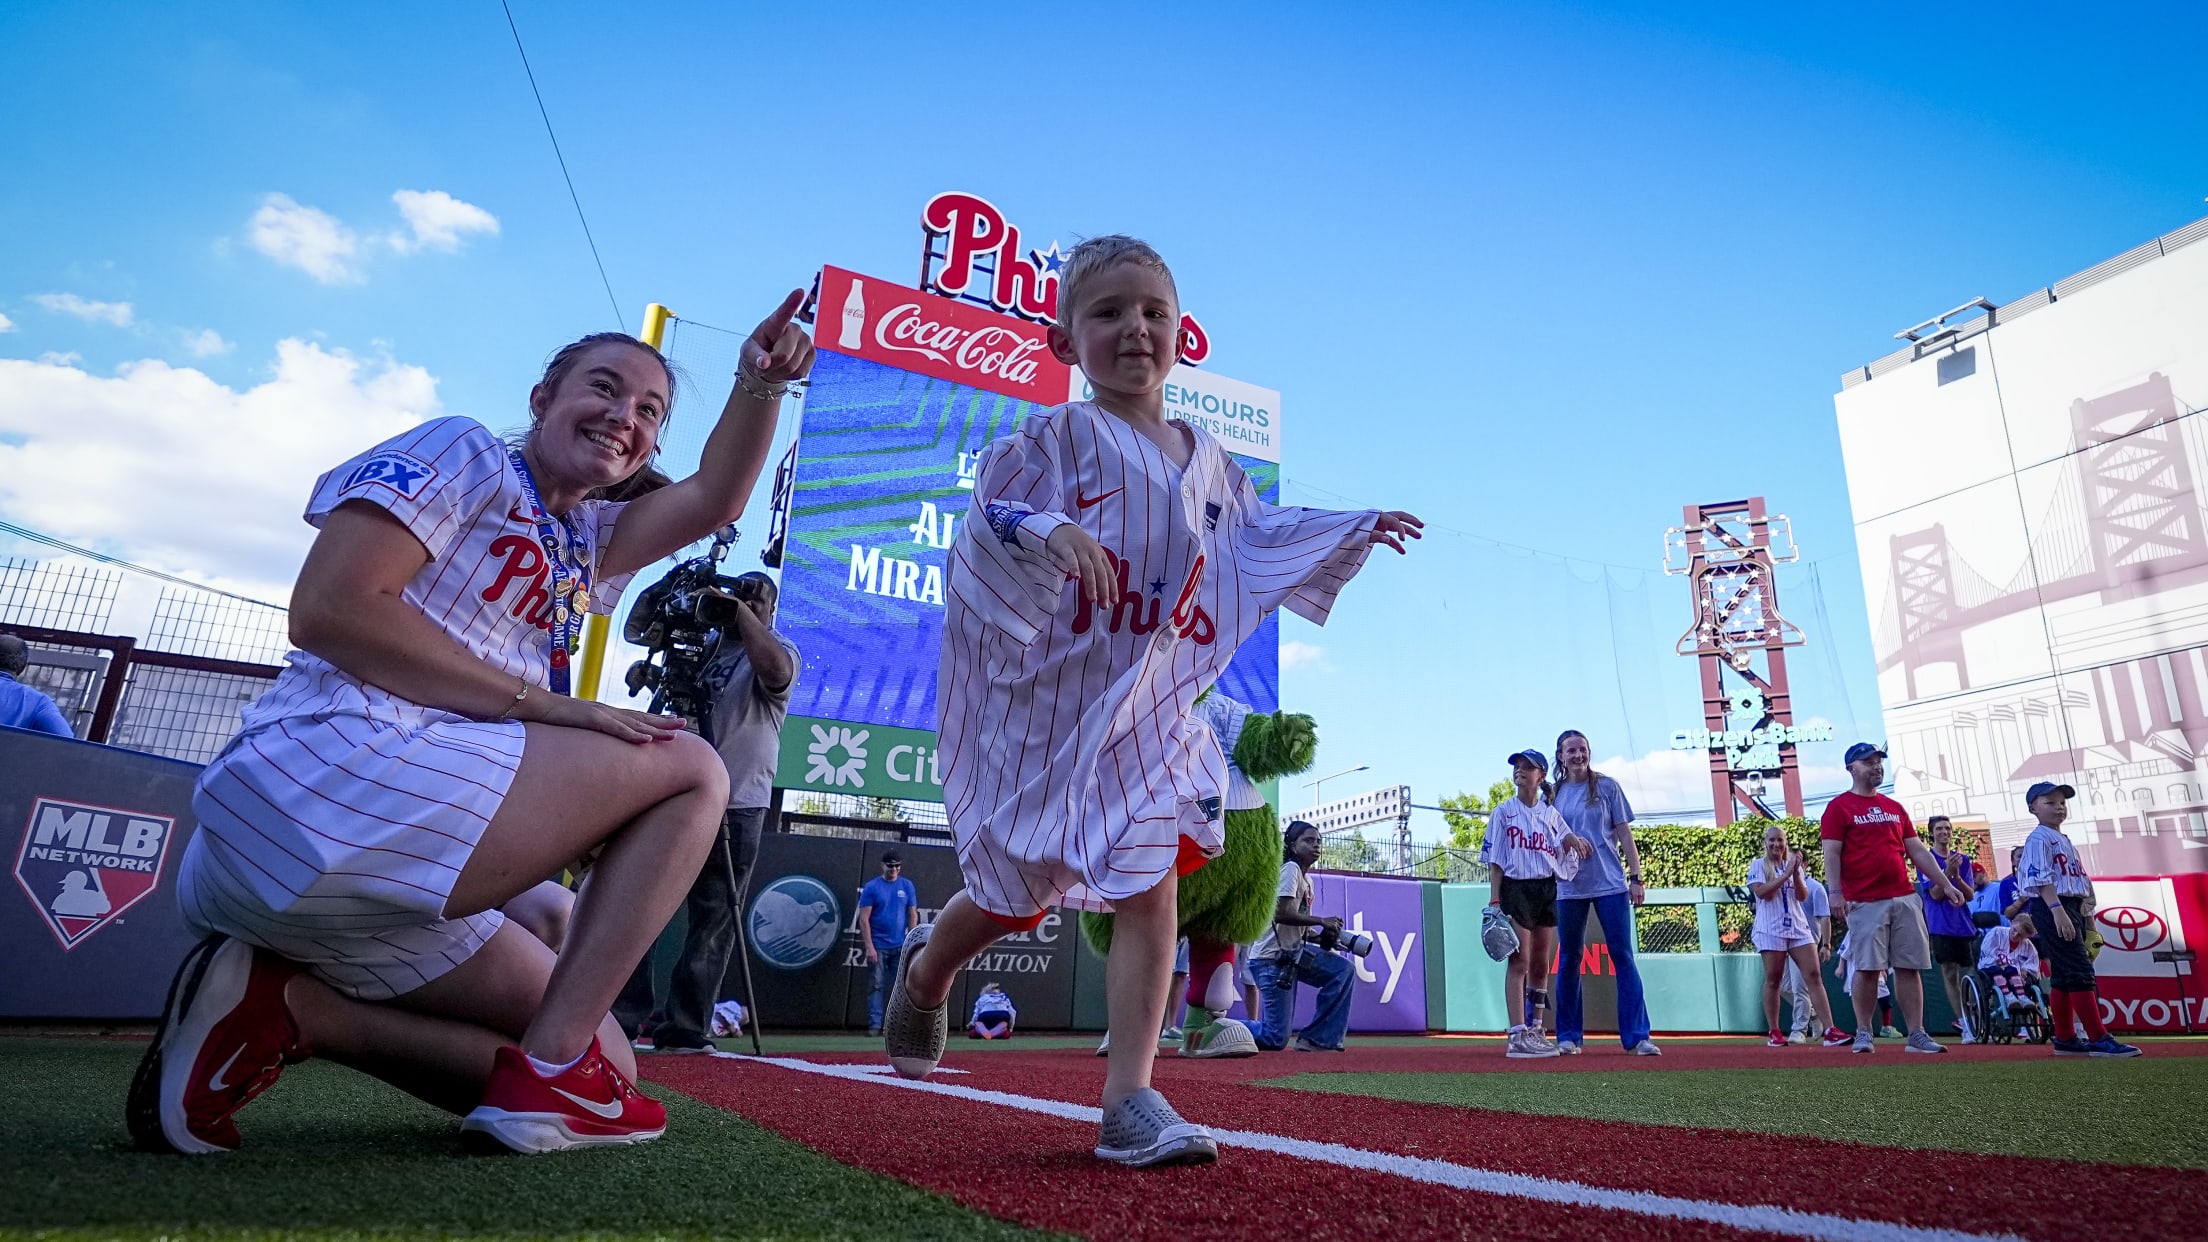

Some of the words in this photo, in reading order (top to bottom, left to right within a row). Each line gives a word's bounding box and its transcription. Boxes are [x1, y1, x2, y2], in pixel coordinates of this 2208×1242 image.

[875, 303, 1048, 384] Coca-Cola
[1165, 383, 1270, 427] EMOURS
[1224, 423, 1270, 447] HEALTH
[343, 460, 425, 494] IBX
[909, 501, 956, 550] AL
[845, 543, 947, 605] MIRA
[1670, 728, 1764, 749] Citizens
[1769, 721, 1833, 743] Bank
[886, 745, 942, 785] Cit
[1726, 745, 1782, 770] Park
[34, 806, 164, 857] MLB
[29, 847, 153, 872] NETWORK
